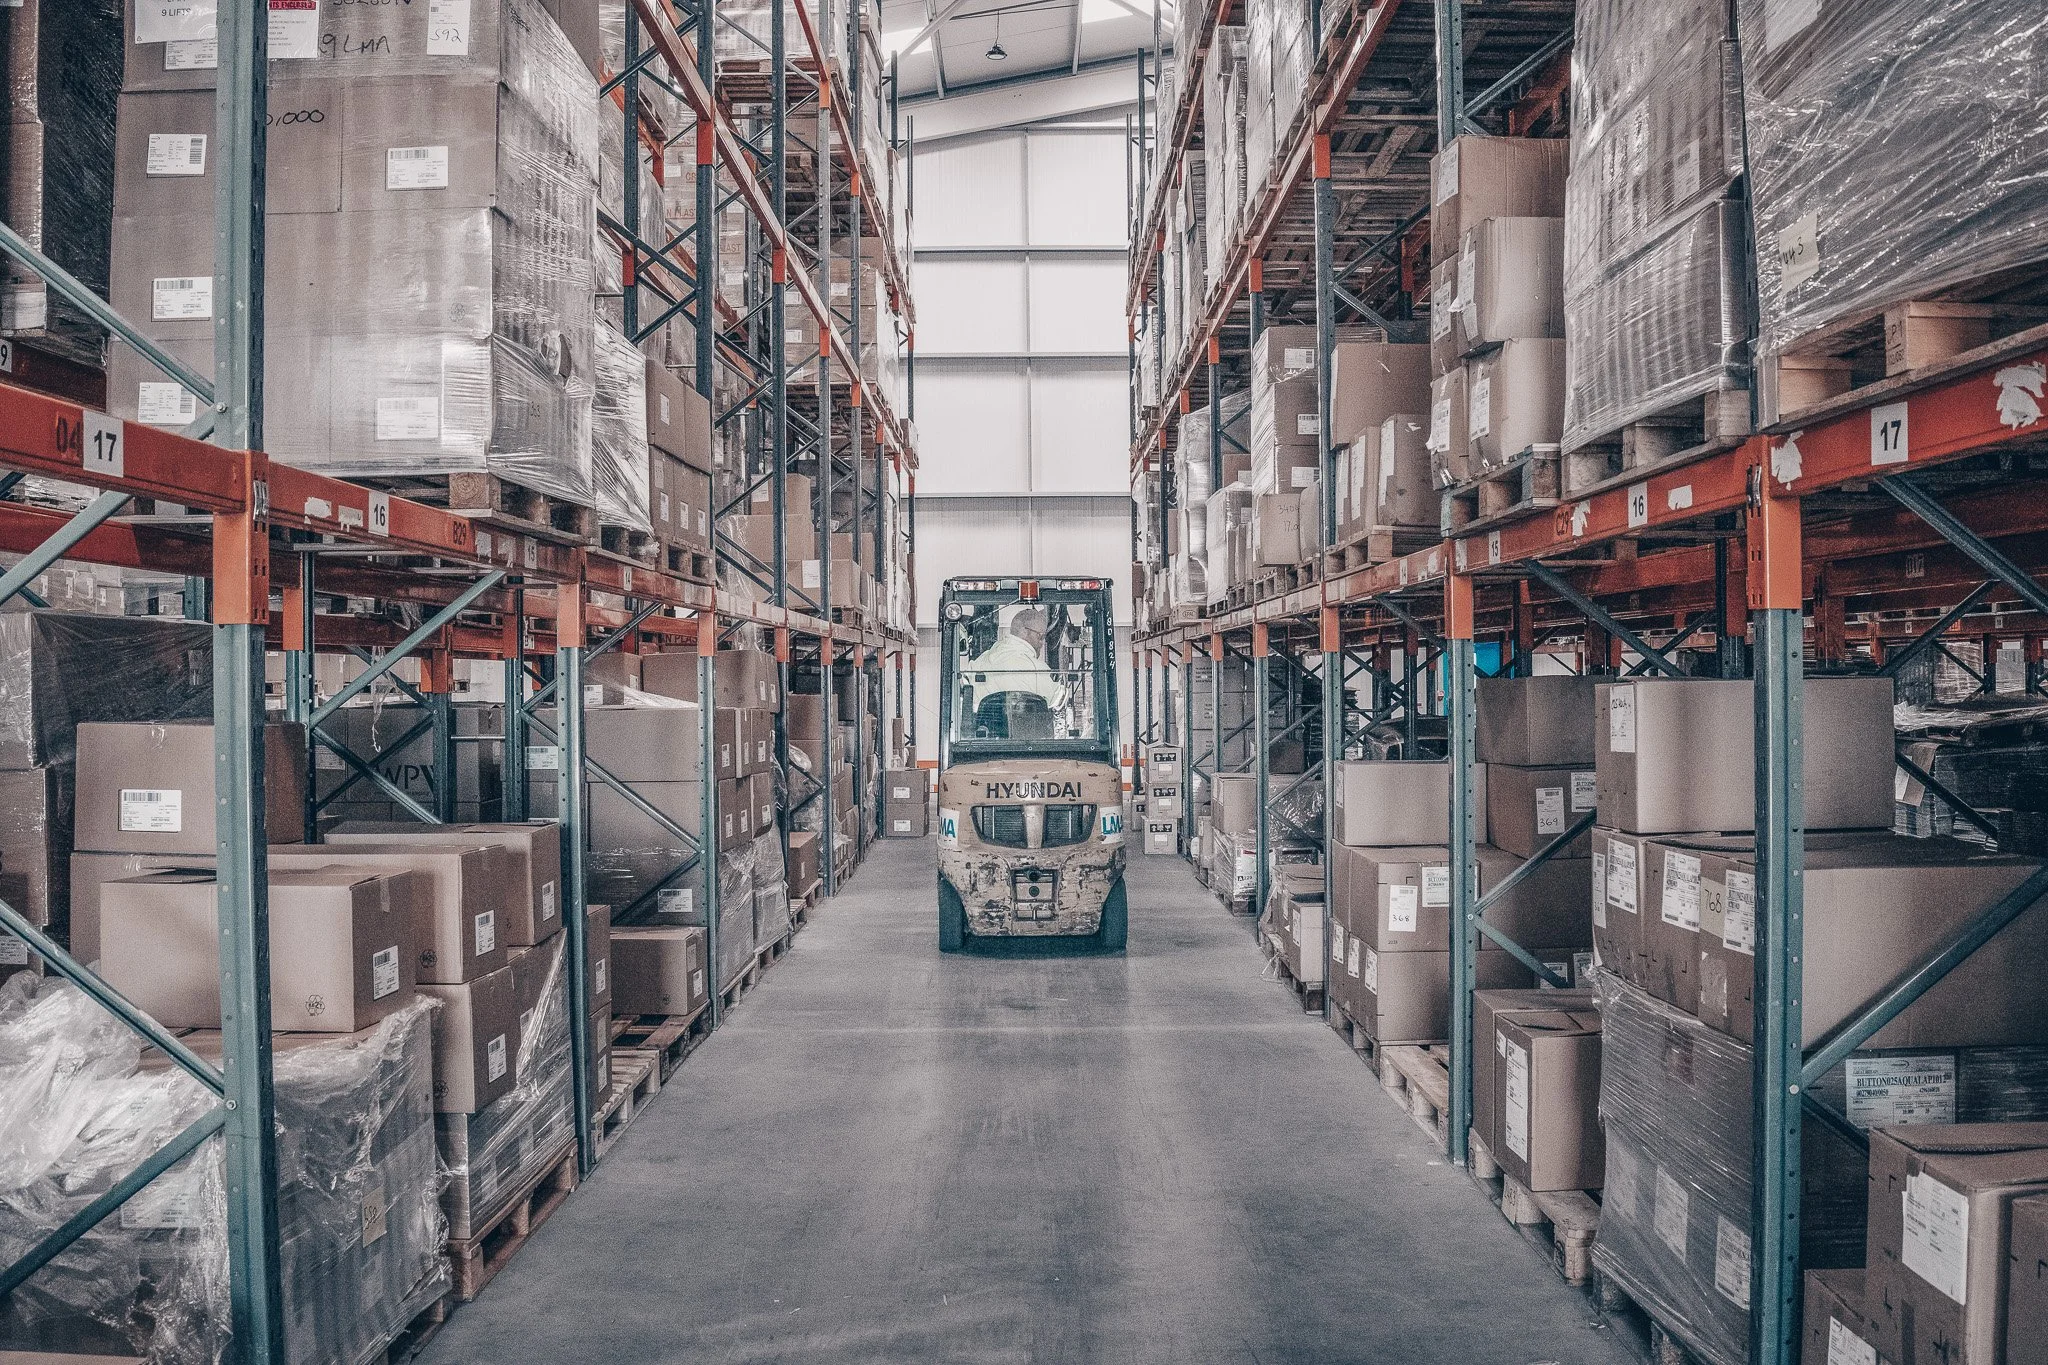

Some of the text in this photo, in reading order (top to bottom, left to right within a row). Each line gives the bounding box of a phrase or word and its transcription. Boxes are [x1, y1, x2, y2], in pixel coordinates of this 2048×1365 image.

[161, 9, 167, 17] 9
[94, 429, 117, 462] 17
[1880, 419, 1902, 451] 17
[373, 503, 386, 527] 16
[1633, 495, 1644, 518] 16
[453, 520, 467, 546] B29
[528, 545, 535, 562] 15
[1491, 541, 1499, 557] 15
[674, 634, 698, 643] PLAS
[986, 781, 1082, 799] HYUNDAI
[1704, 888, 1722, 914] 768
